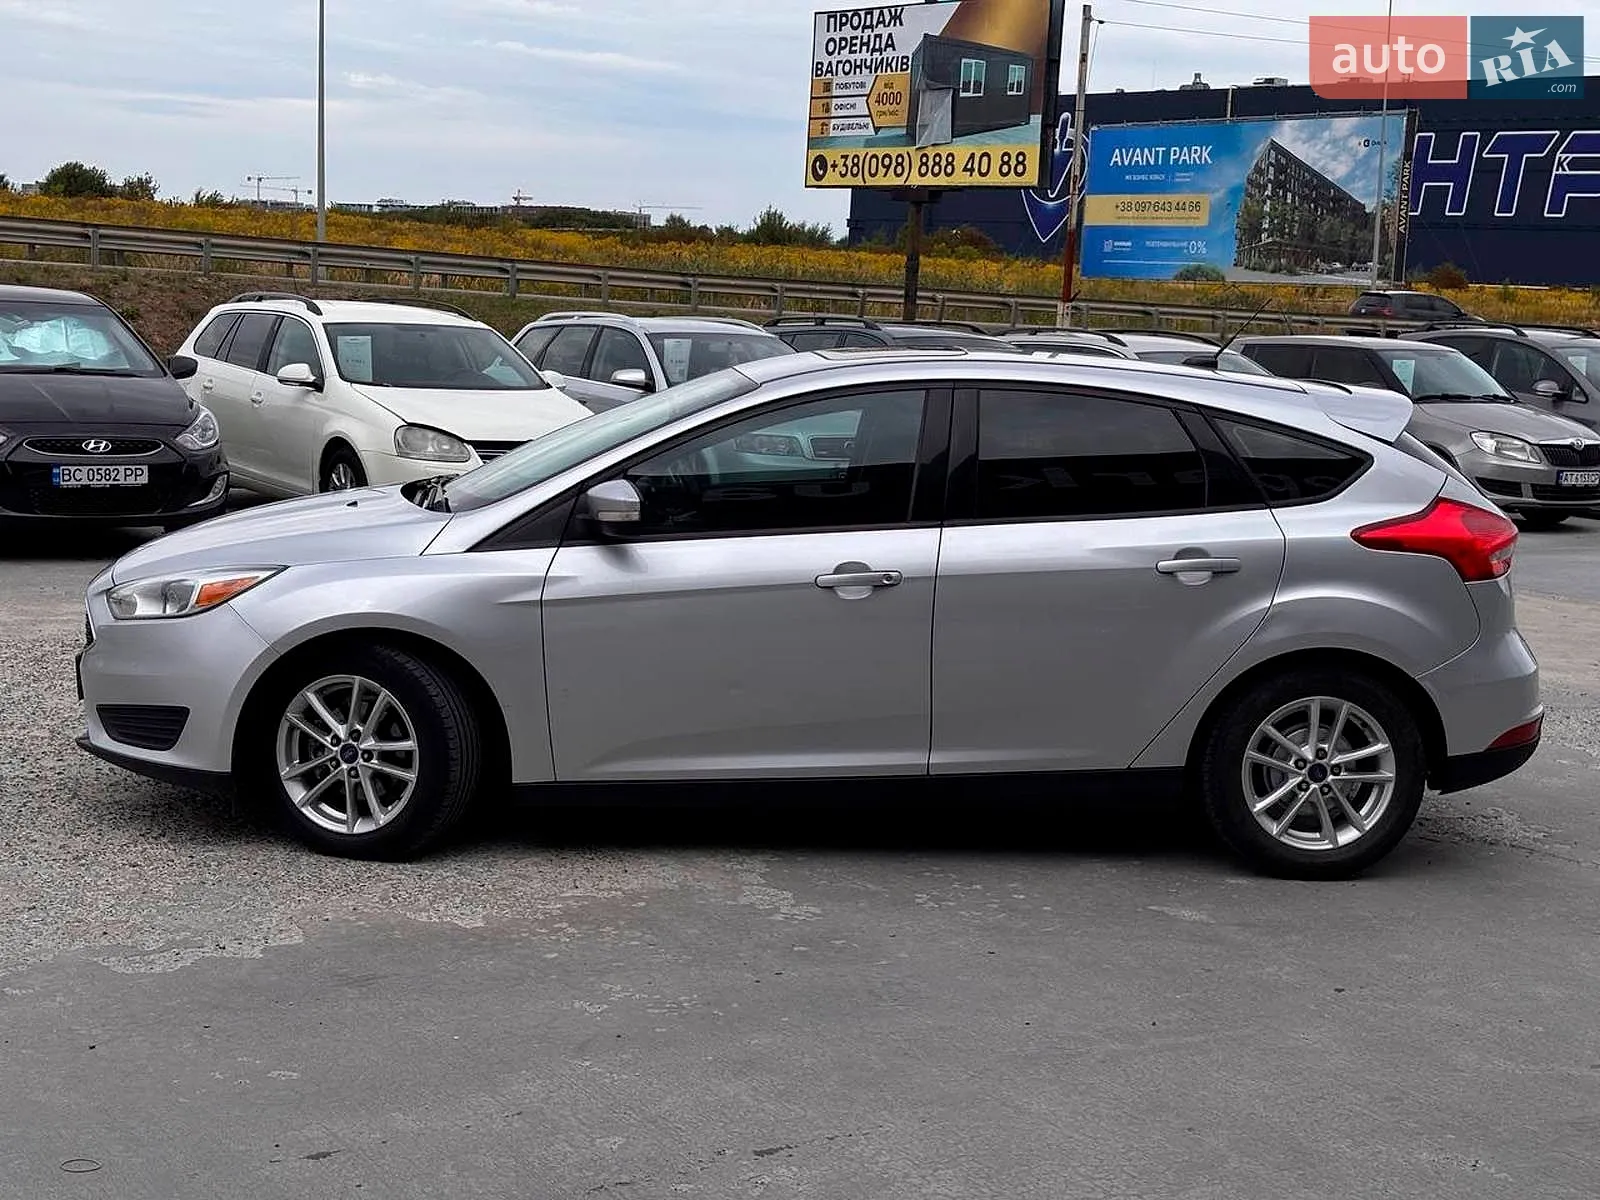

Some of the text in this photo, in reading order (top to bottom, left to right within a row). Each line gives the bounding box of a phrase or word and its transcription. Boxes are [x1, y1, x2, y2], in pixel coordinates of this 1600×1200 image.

[826, 7, 904, 33] ПРОДАЖ
[825, 32, 896, 56] ОРЕНДА
[814, 55, 910, 77] ВАГОНЧИКІВ
[874, 91, 902, 106] 4000
[830, 151, 1027, 184] +38(098) 888 40 88
[1109, 145, 1213, 167] AVANT PARK
[1398, 160, 1411, 233] AVANT PARK
[62, 467, 144, 482] BC 0582 PP
